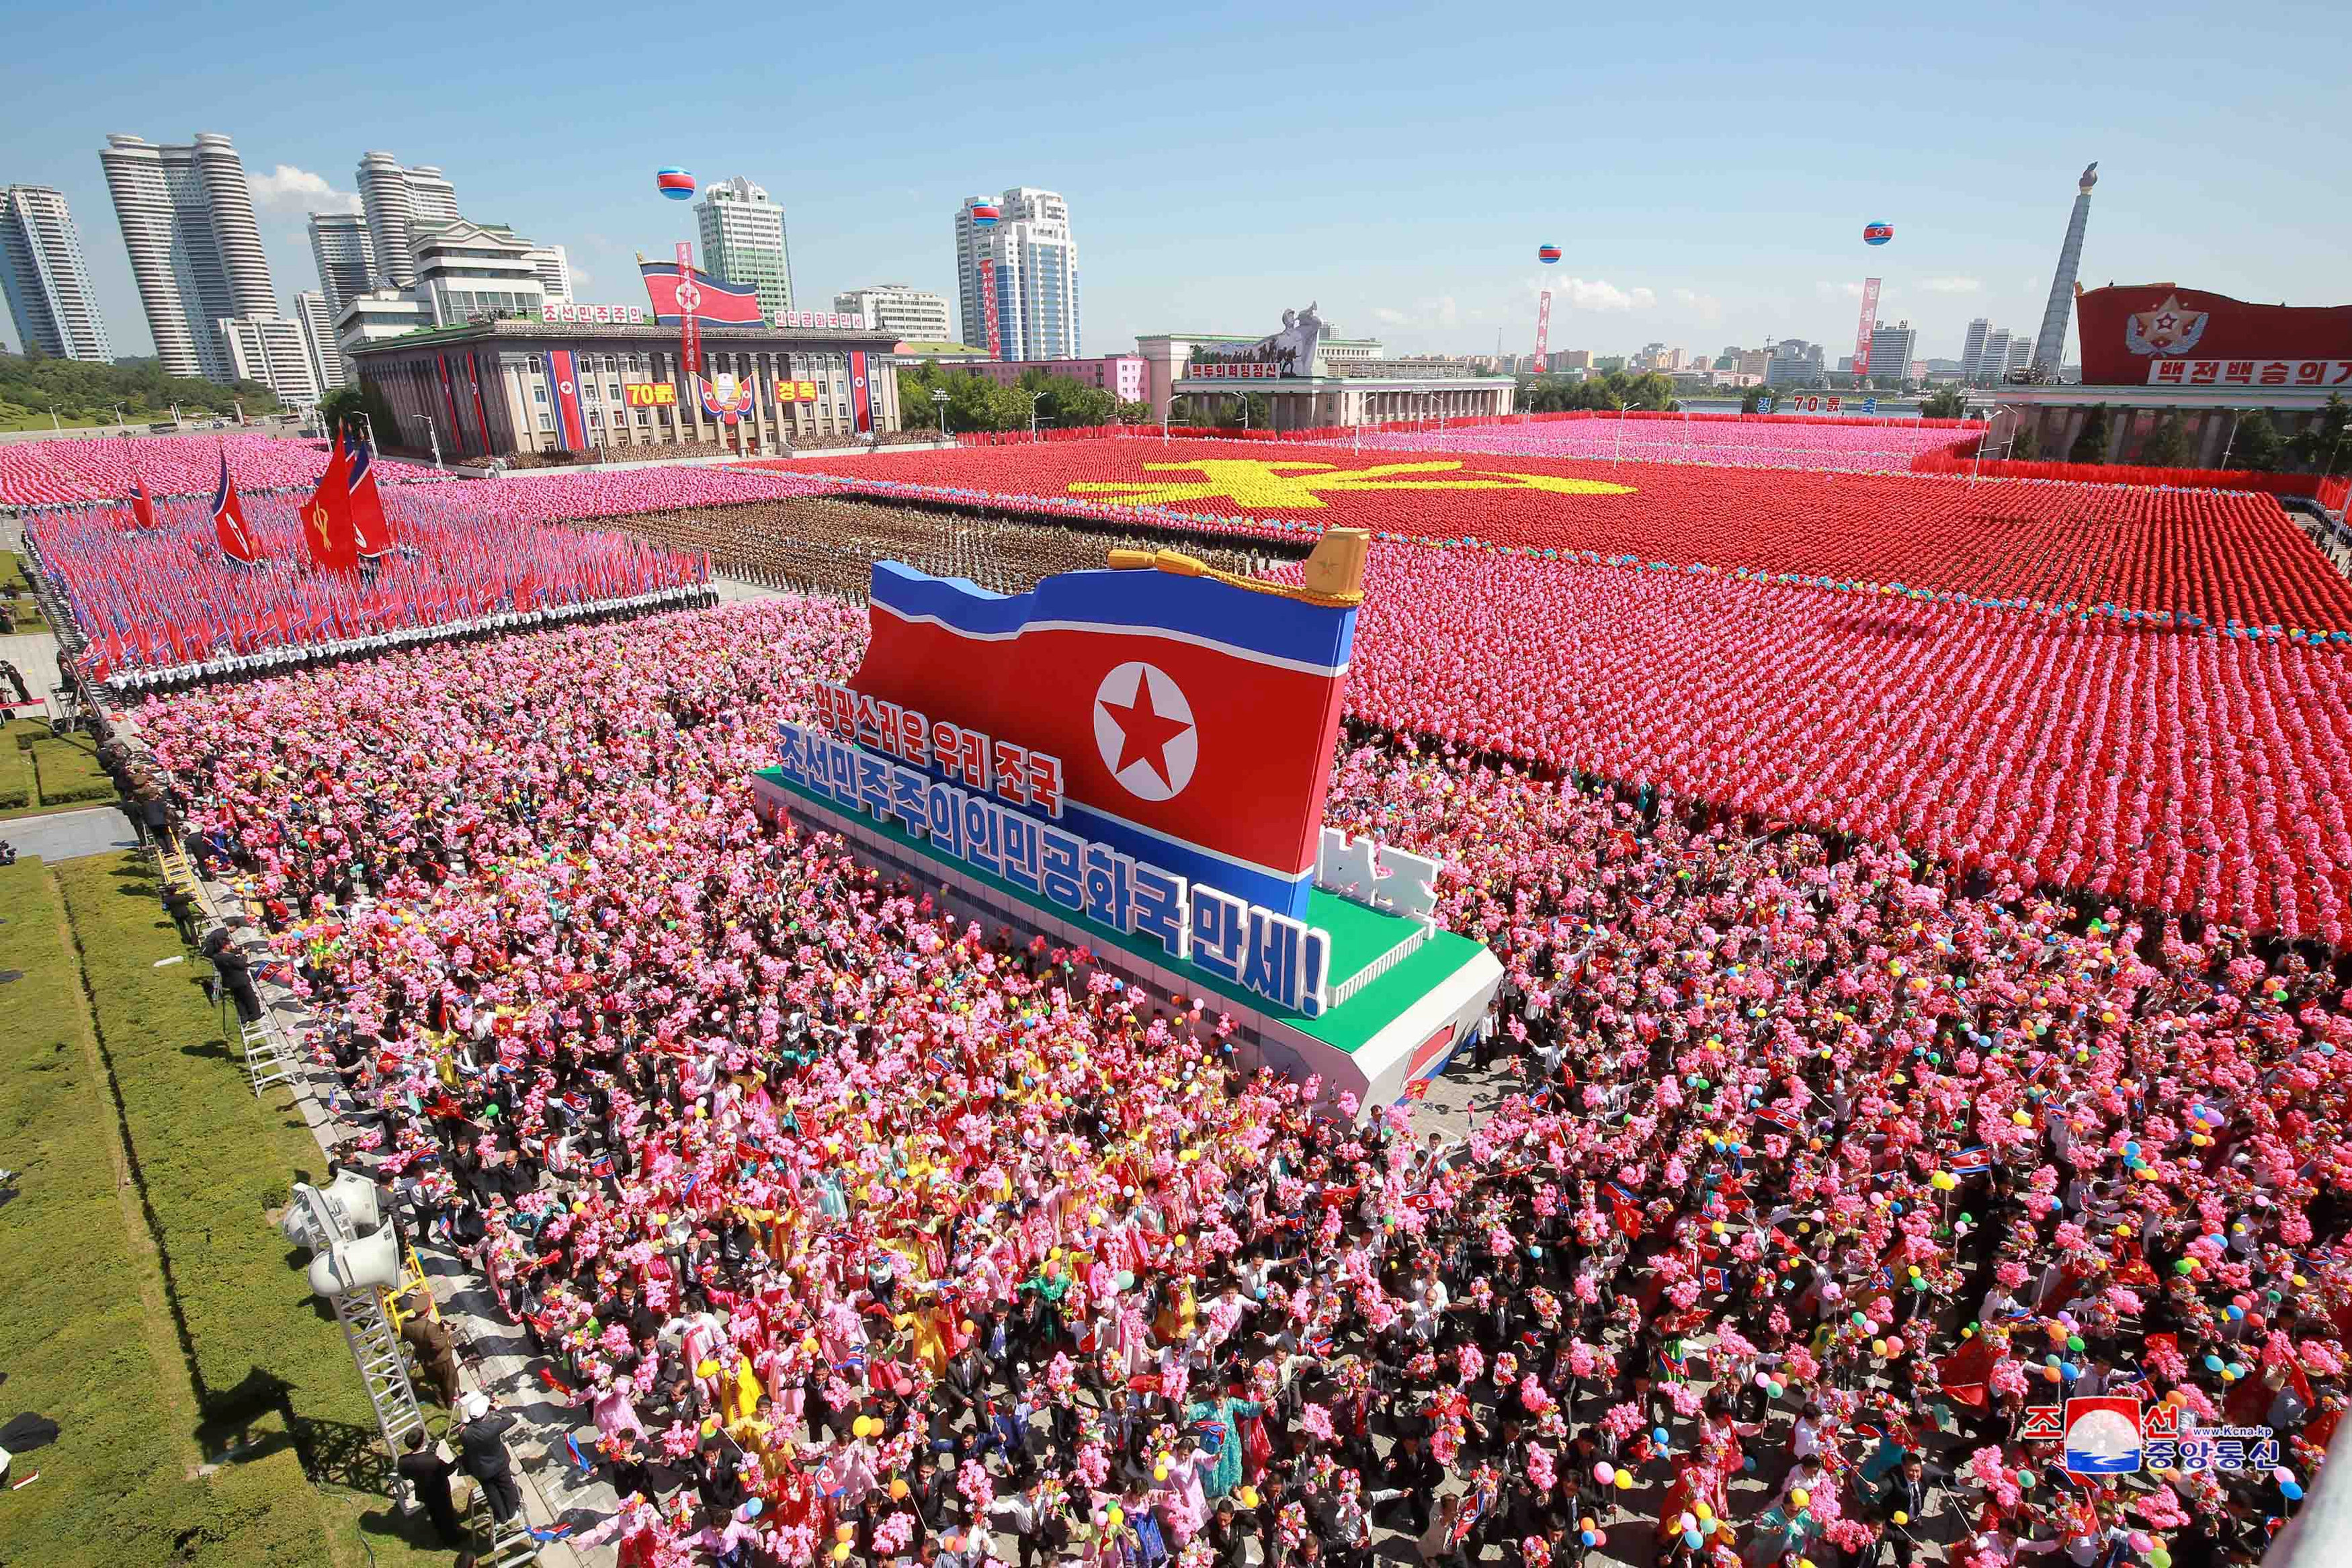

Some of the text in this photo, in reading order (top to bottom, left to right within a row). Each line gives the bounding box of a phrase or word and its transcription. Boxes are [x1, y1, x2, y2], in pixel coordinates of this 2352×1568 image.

[543, 305, 642, 322] 조선민주주의
[777, 381, 816, 400] 경축
[814, 680, 1063, 818] 영광스러운 우리 조국
[777, 719, 1330, 1020] 조선민주주의인민공화국 만세!
